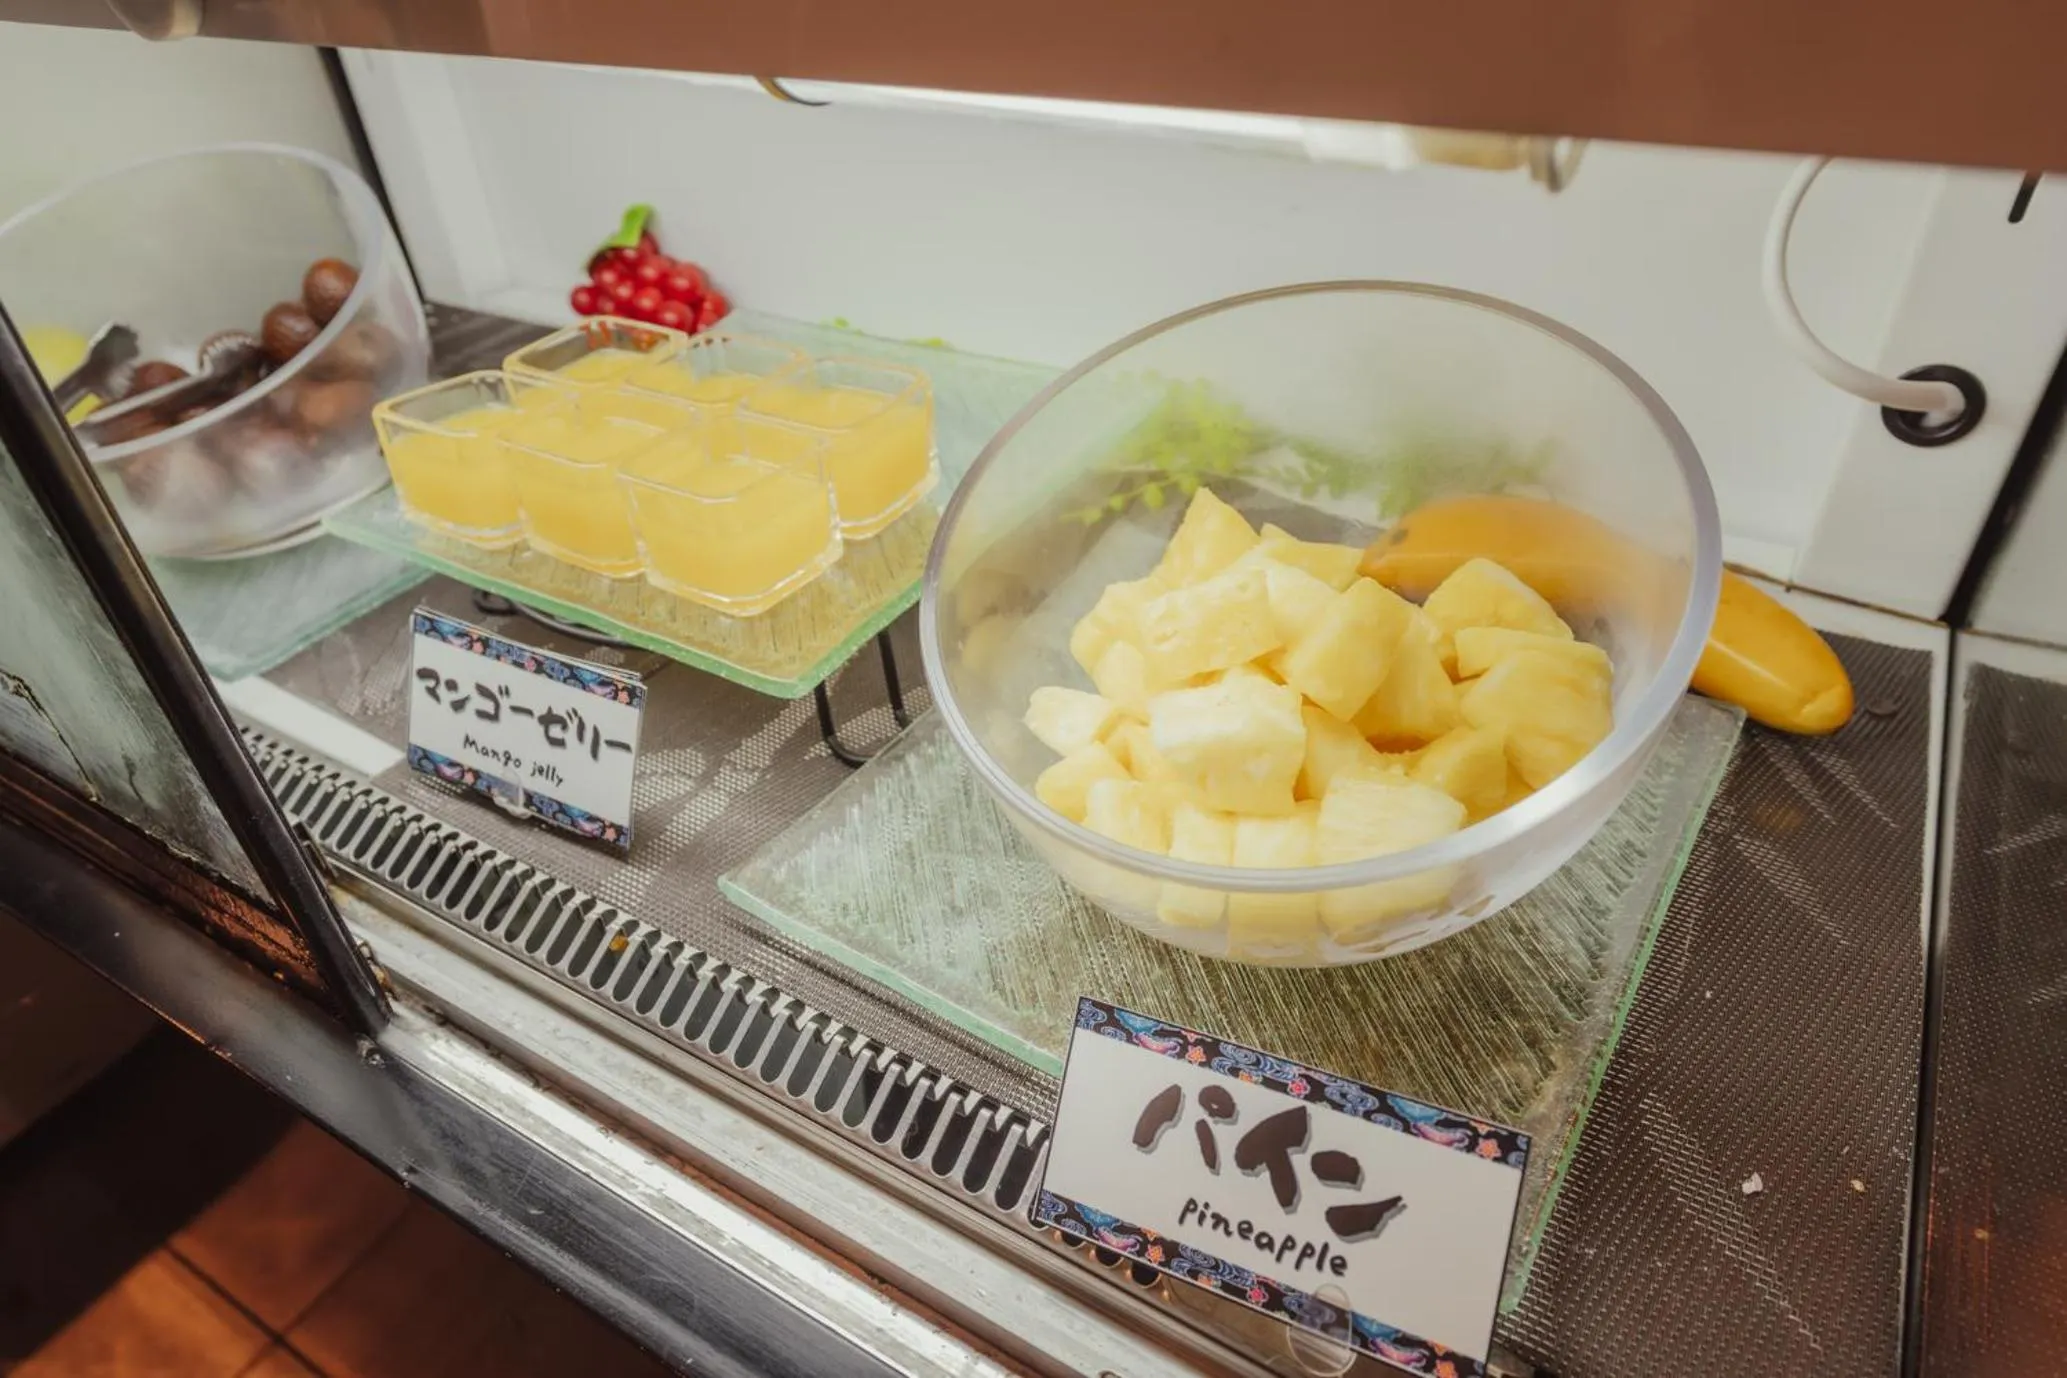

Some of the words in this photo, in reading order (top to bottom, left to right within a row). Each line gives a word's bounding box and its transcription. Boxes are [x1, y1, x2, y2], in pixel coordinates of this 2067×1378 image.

[416, 667, 632, 761] マンゴーゼリー
[463, 734, 522, 769] Mango
[530, 761, 564, 787] jelly
[1132, 1083, 1407, 1242] パイン
[1178, 1197, 1348, 1277] pineapple
